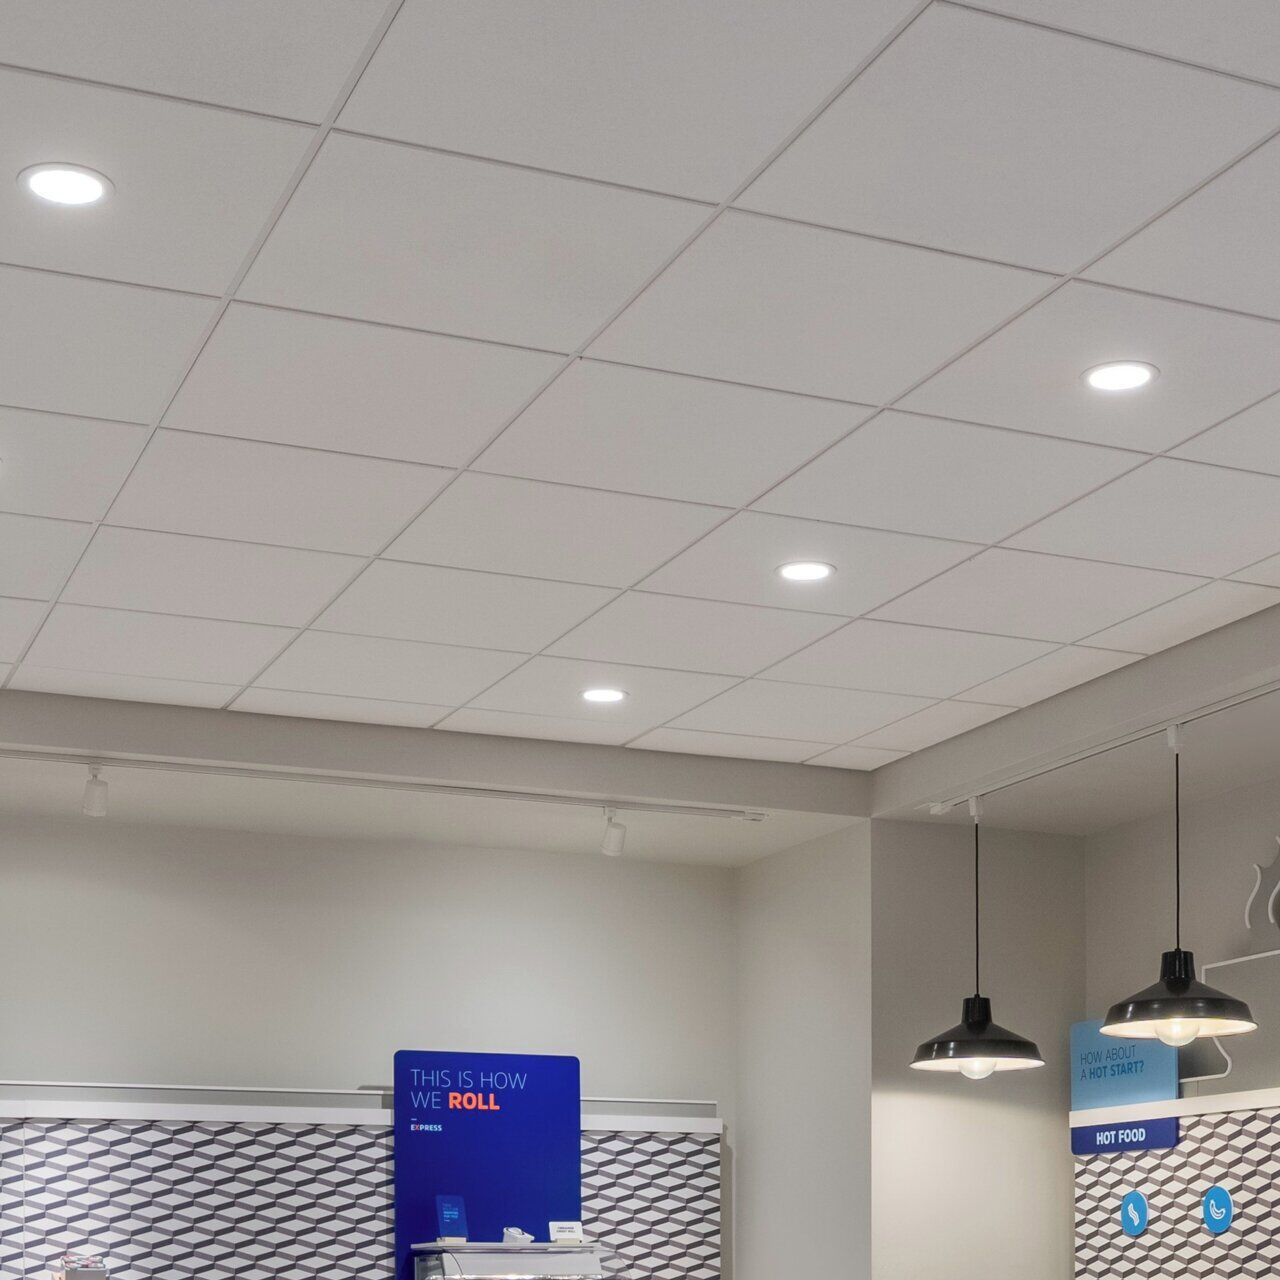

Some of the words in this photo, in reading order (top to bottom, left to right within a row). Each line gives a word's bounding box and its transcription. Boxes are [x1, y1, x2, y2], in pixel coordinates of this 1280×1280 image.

[1080, 1050, 1102, 1066] HOW
[1106, 1044, 1136, 1061] ABOUT
[410, 1069, 451, 1088] THIS
[458, 1070, 473, 1088] IS
[480, 1072, 527, 1090] HOW
[1080, 1069, 1087, 1080] A
[1089, 1066, 1108, 1079] HOT
[1110, 1060, 1145, 1076] START?
[410, 1091, 441, 1109] WE
[448, 1092, 500, 1110] ROLL
[1096, 1131, 1116, 1145] HOT
[1118, 1128, 1146, 1143] FOOD
